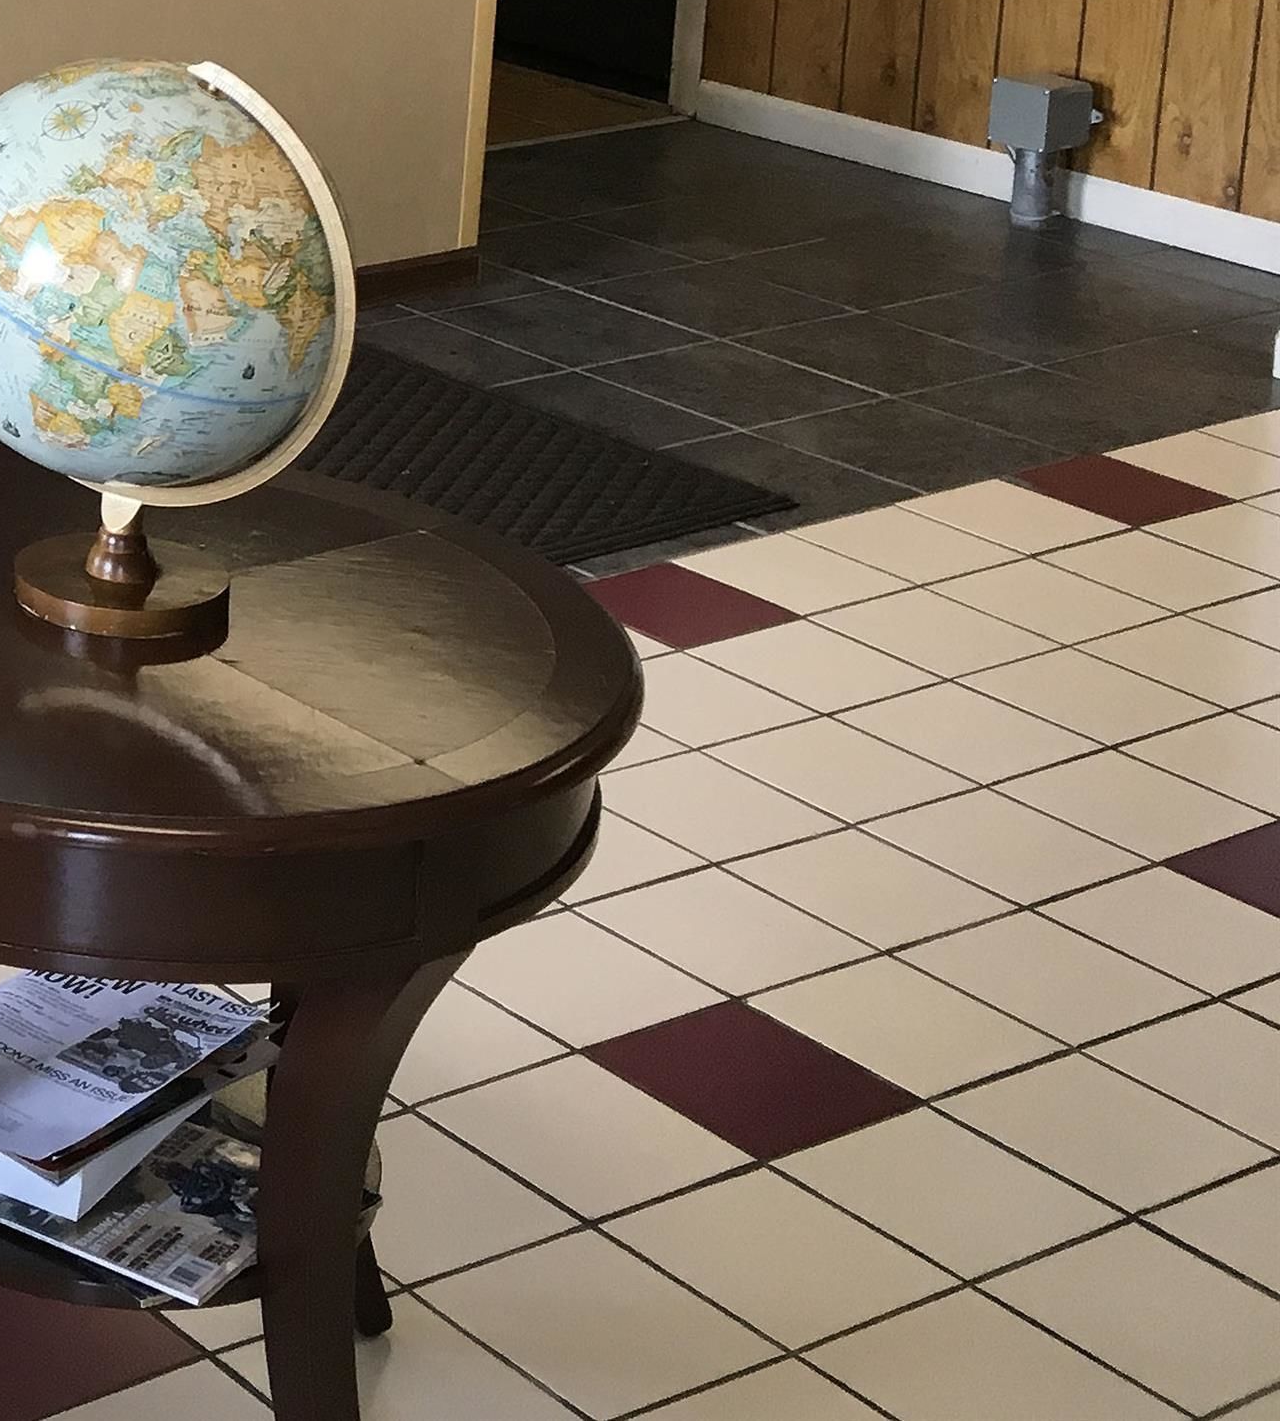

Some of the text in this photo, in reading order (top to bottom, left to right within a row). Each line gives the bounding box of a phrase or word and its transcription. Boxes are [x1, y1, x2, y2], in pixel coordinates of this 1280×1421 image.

[172, 982, 221, 1006] LAST
[34, 1062, 71, 1081] MISS
[68, 1078, 92, 1090] AN
